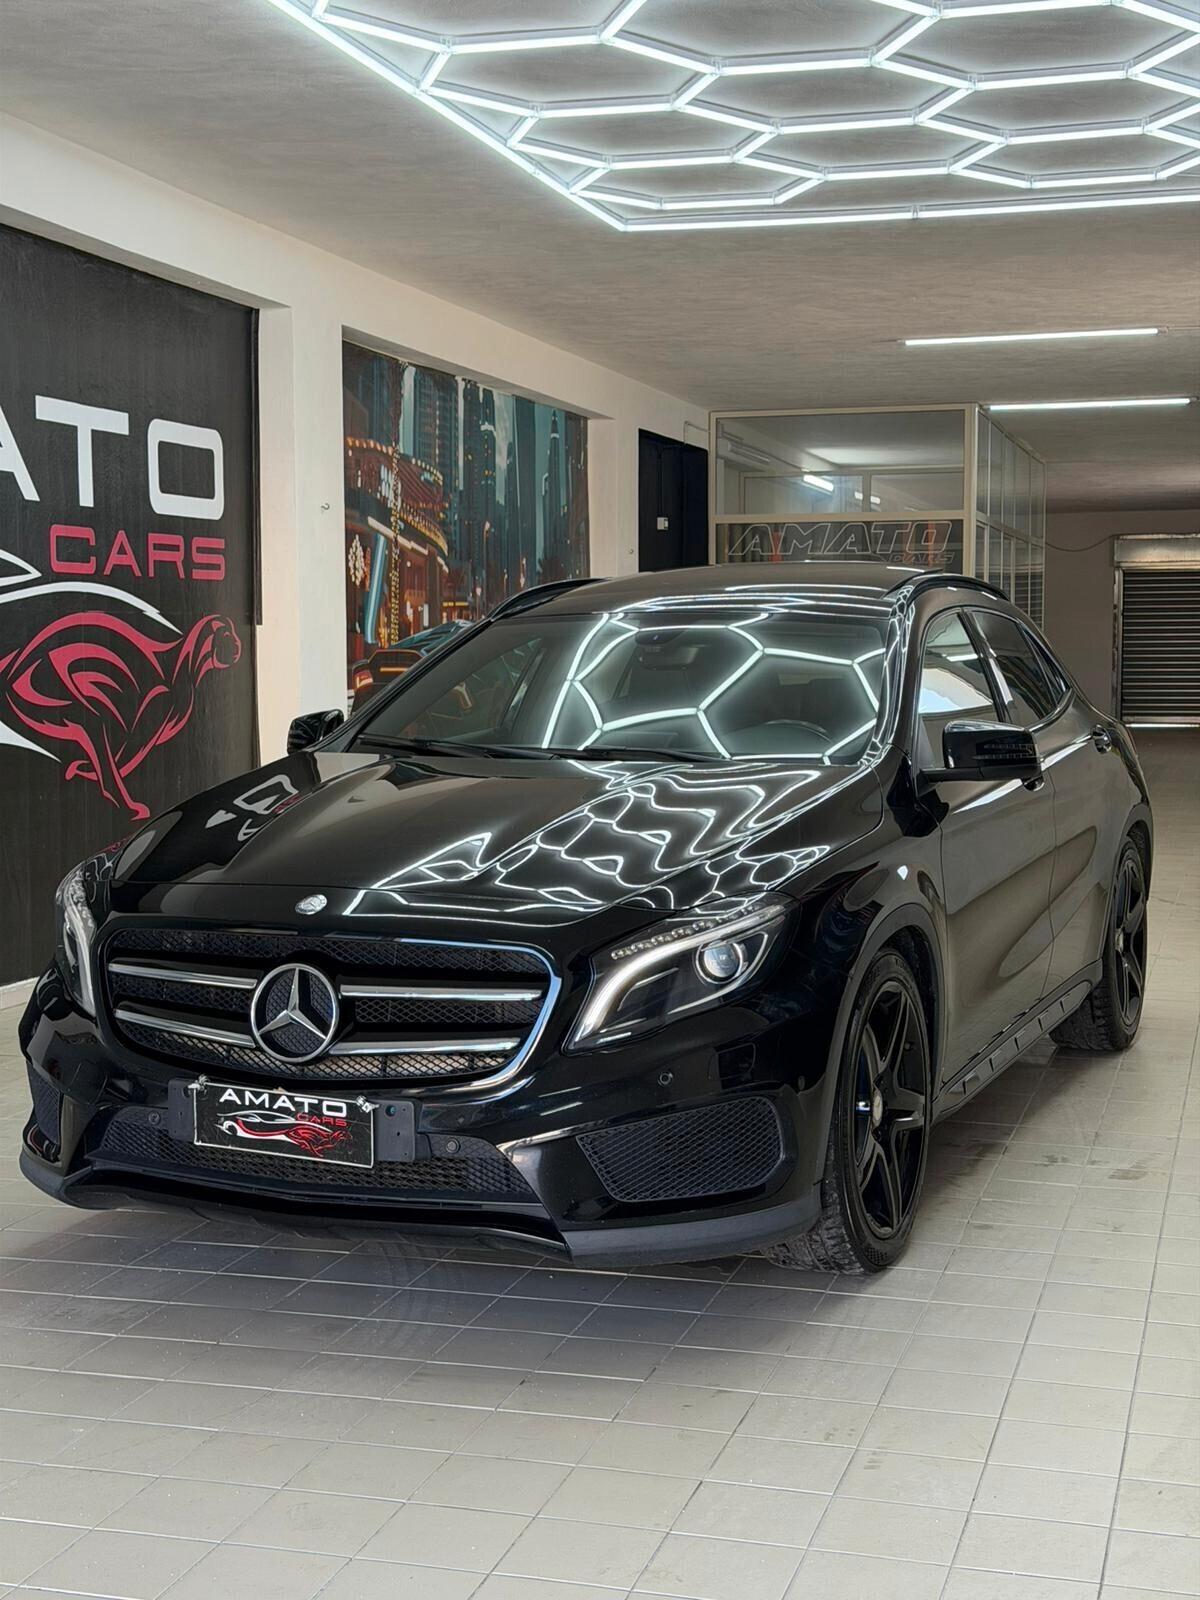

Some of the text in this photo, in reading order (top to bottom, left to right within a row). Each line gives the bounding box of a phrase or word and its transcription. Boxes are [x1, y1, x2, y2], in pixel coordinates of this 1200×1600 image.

[49, 524, 226, 581] CARS
[728, 521, 952, 556] AMATO
[219, 1088, 347, 1118] AMATO
[296, 1112, 348, 1127] CARS
